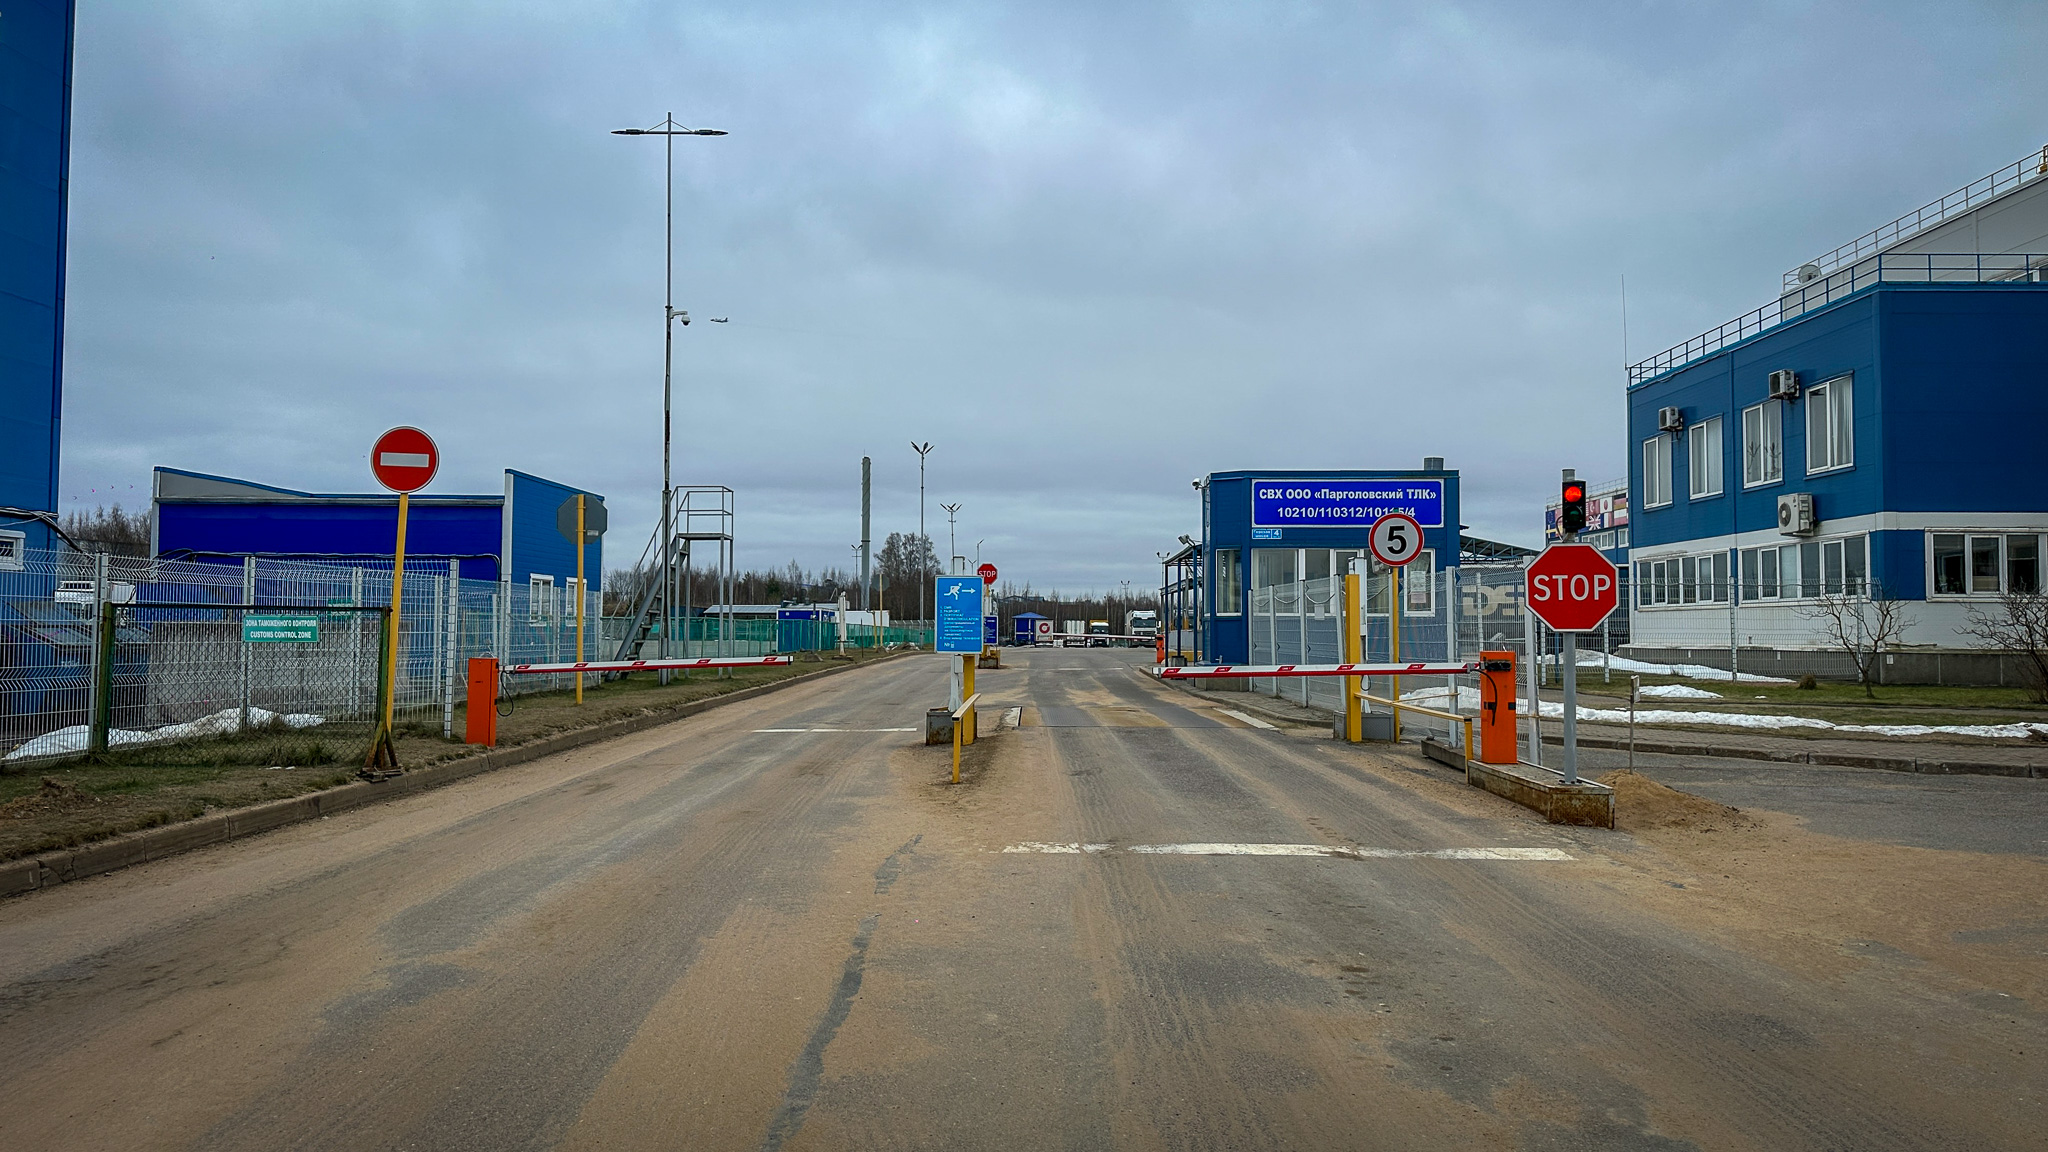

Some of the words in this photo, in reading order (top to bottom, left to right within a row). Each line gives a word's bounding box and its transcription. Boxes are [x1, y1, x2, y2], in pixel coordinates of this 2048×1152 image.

[1259, 489, 1283, 499] СВХ
[1286, 489, 1311, 499] ООО
[1314, 489, 1403, 501] «Парголовский
[1407, 489, 1437, 499] ТЛК»
[1387, 525, 1407, 555] 5
[978, 570, 996, 578] STOP
[1533, 574, 1611, 601] STOP
[245, 619, 258, 627] ЗОНА
[258, 619, 292, 627] ТАМОЖЕННОГО
